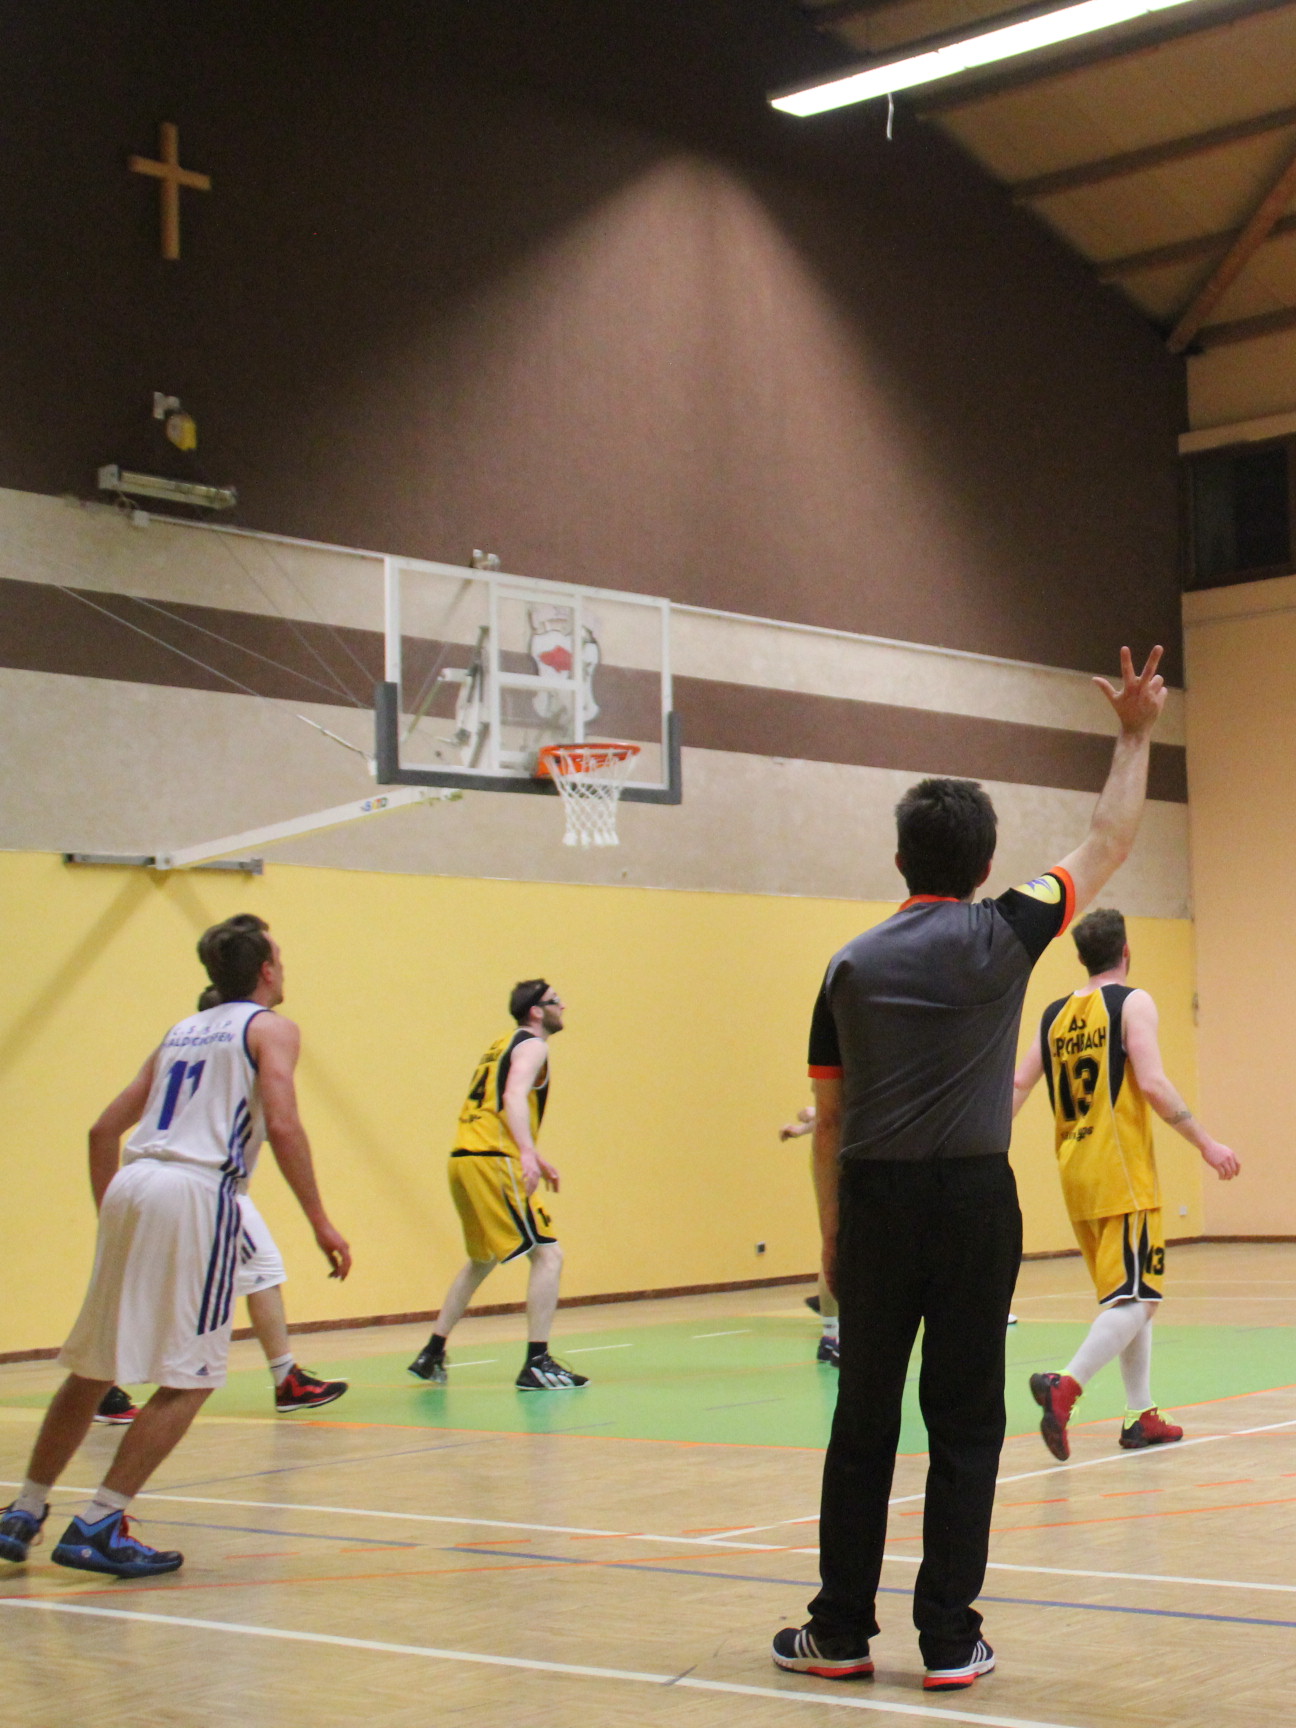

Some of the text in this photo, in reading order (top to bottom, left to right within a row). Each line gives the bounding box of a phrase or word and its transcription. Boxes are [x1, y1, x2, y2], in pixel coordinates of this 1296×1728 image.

[157, 1060, 206, 1130] 11
[1059, 1055, 1099, 1121] 13
[1146, 1245, 1165, 1276] 13
